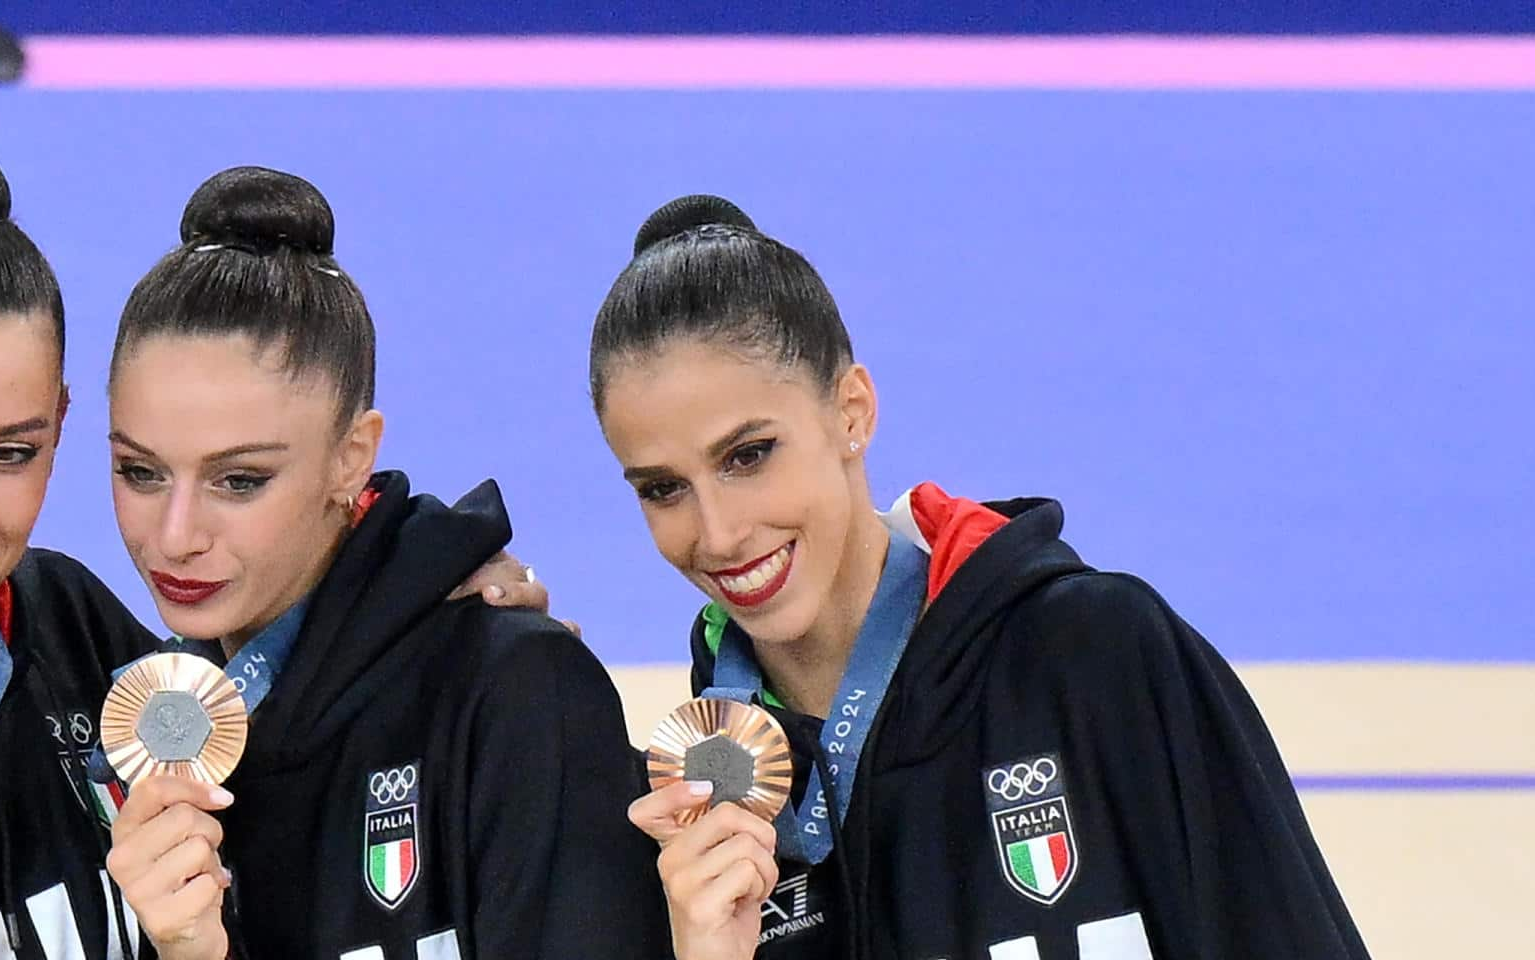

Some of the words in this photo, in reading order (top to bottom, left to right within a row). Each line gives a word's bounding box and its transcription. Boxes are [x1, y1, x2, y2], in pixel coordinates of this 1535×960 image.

[232, 652, 267, 693] 024
[829, 689, 867, 755] 2024
[370, 811, 412, 832] ITALIA
[999, 805, 1062, 832] ITALIA
[1014, 822, 1054, 838] TEAM
